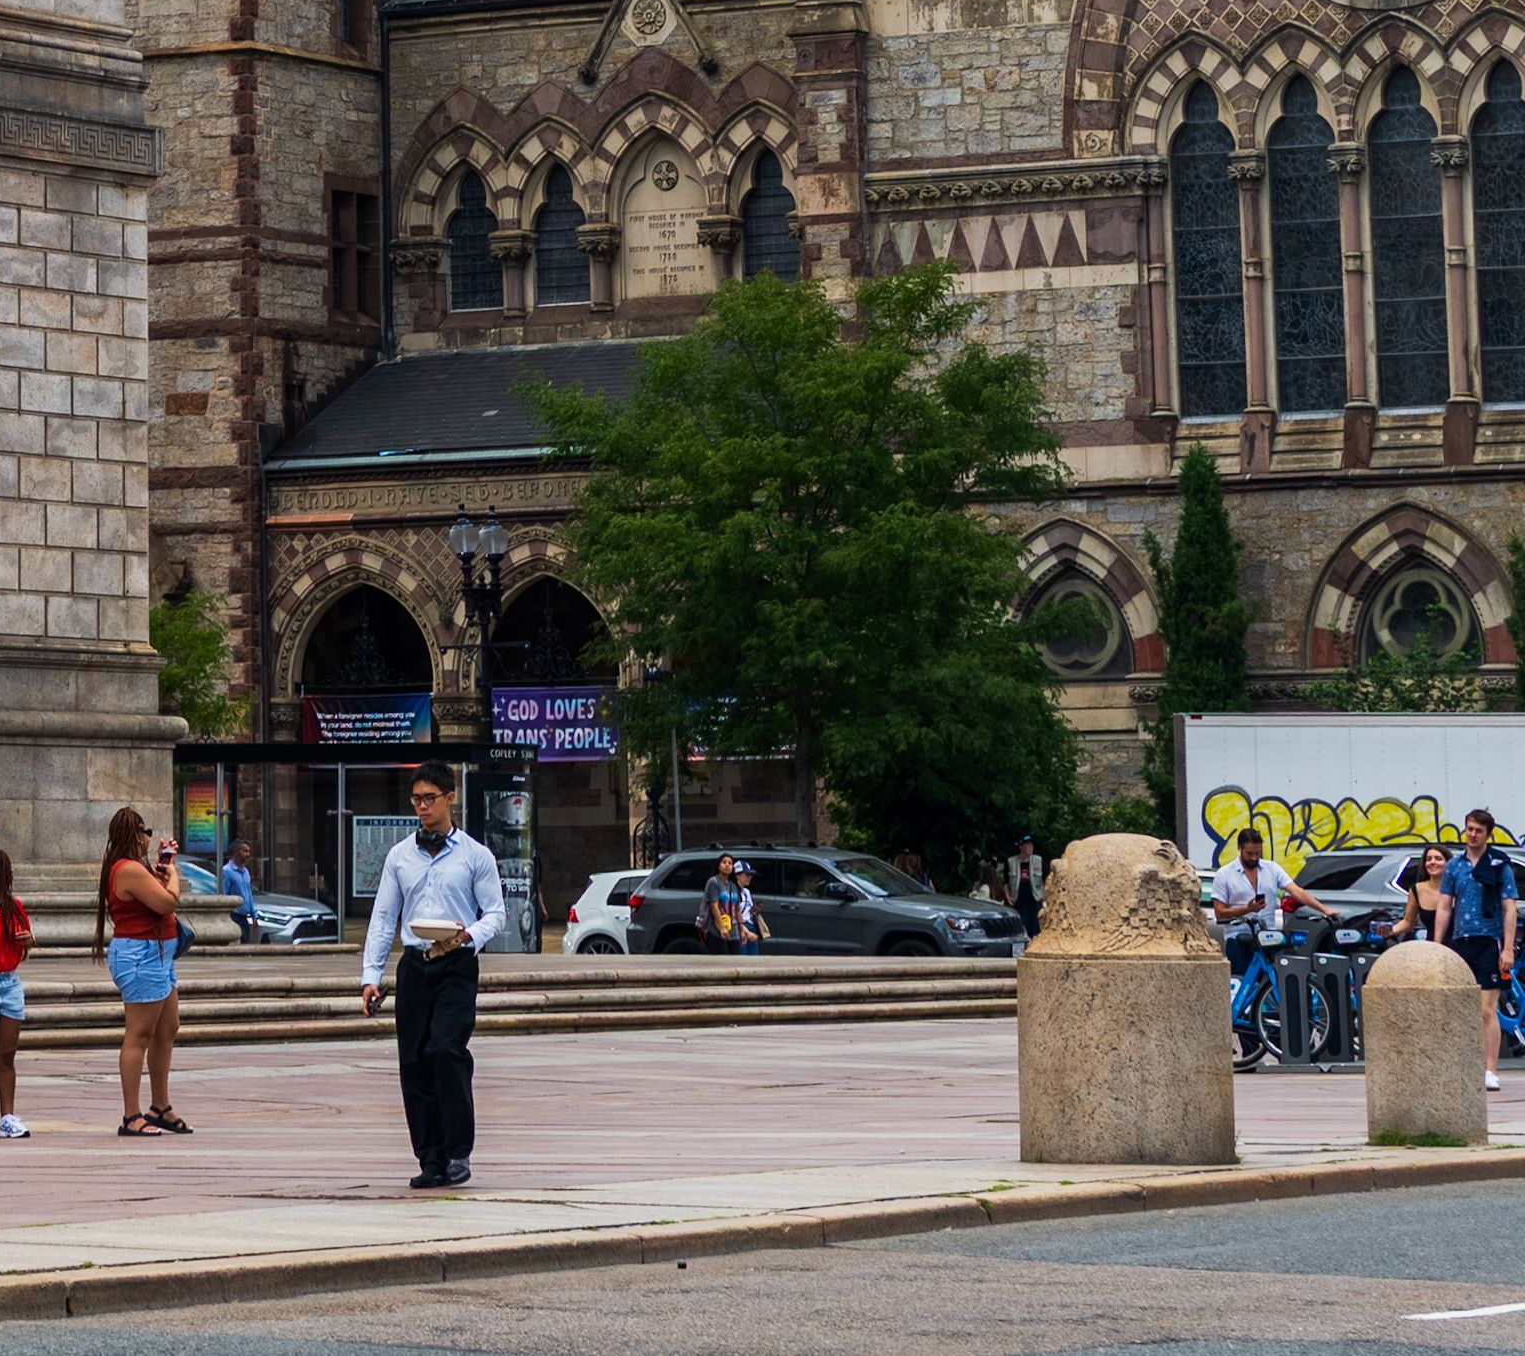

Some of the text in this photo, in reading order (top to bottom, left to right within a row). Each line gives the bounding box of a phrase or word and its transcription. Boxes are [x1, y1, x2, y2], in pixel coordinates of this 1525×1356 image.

[508, 698, 596, 721] GOD LOVES
[493, 727, 611, 749] TRANS PEOPLE
[490, 749, 516, 759] COPLEY
